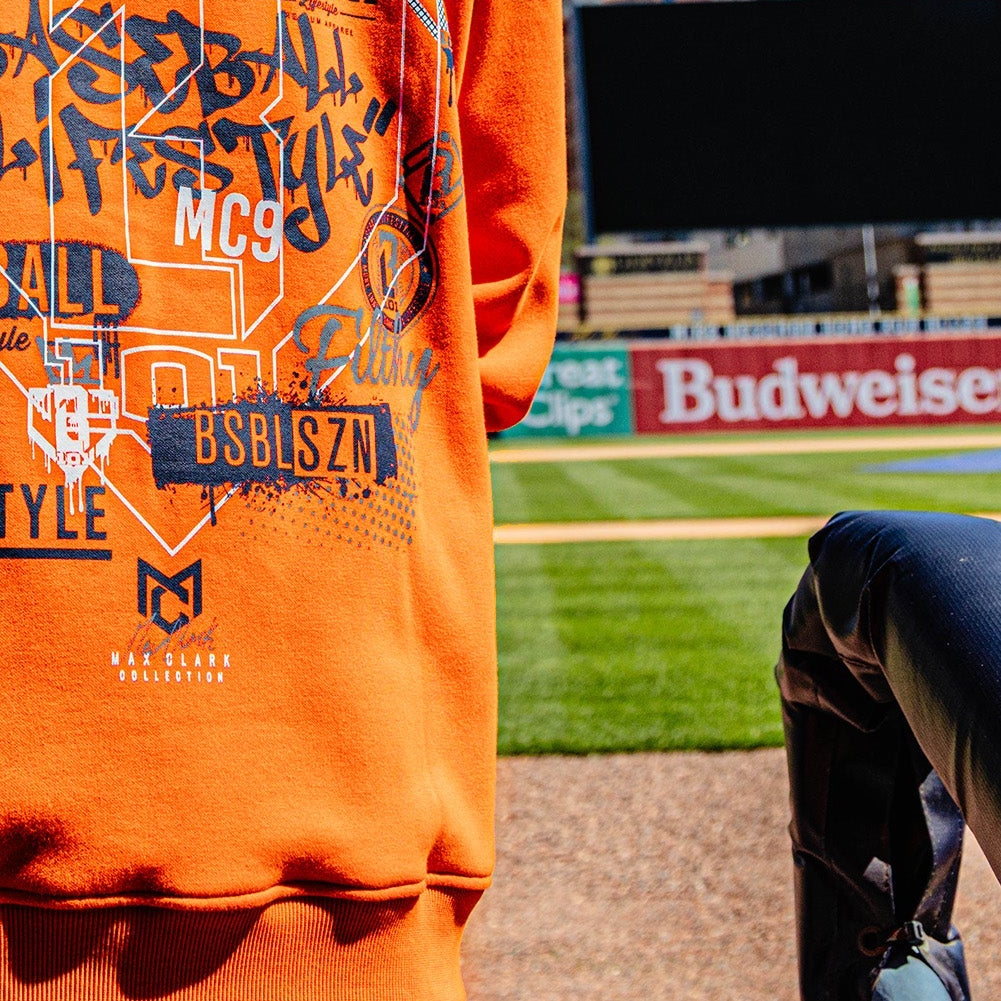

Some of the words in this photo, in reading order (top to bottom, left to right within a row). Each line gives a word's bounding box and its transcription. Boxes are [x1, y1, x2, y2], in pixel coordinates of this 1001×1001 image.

[173, 185, 283, 264] MC9
[541, 354, 624, 389] reat
[656, 352, 1001, 424] Budweise
[194, 408, 377, 478] BSBLSZN
[111, 650, 151, 667] MAX
[165, 652, 231, 668] CLARK
[119, 669, 225, 683] COLLECTION
